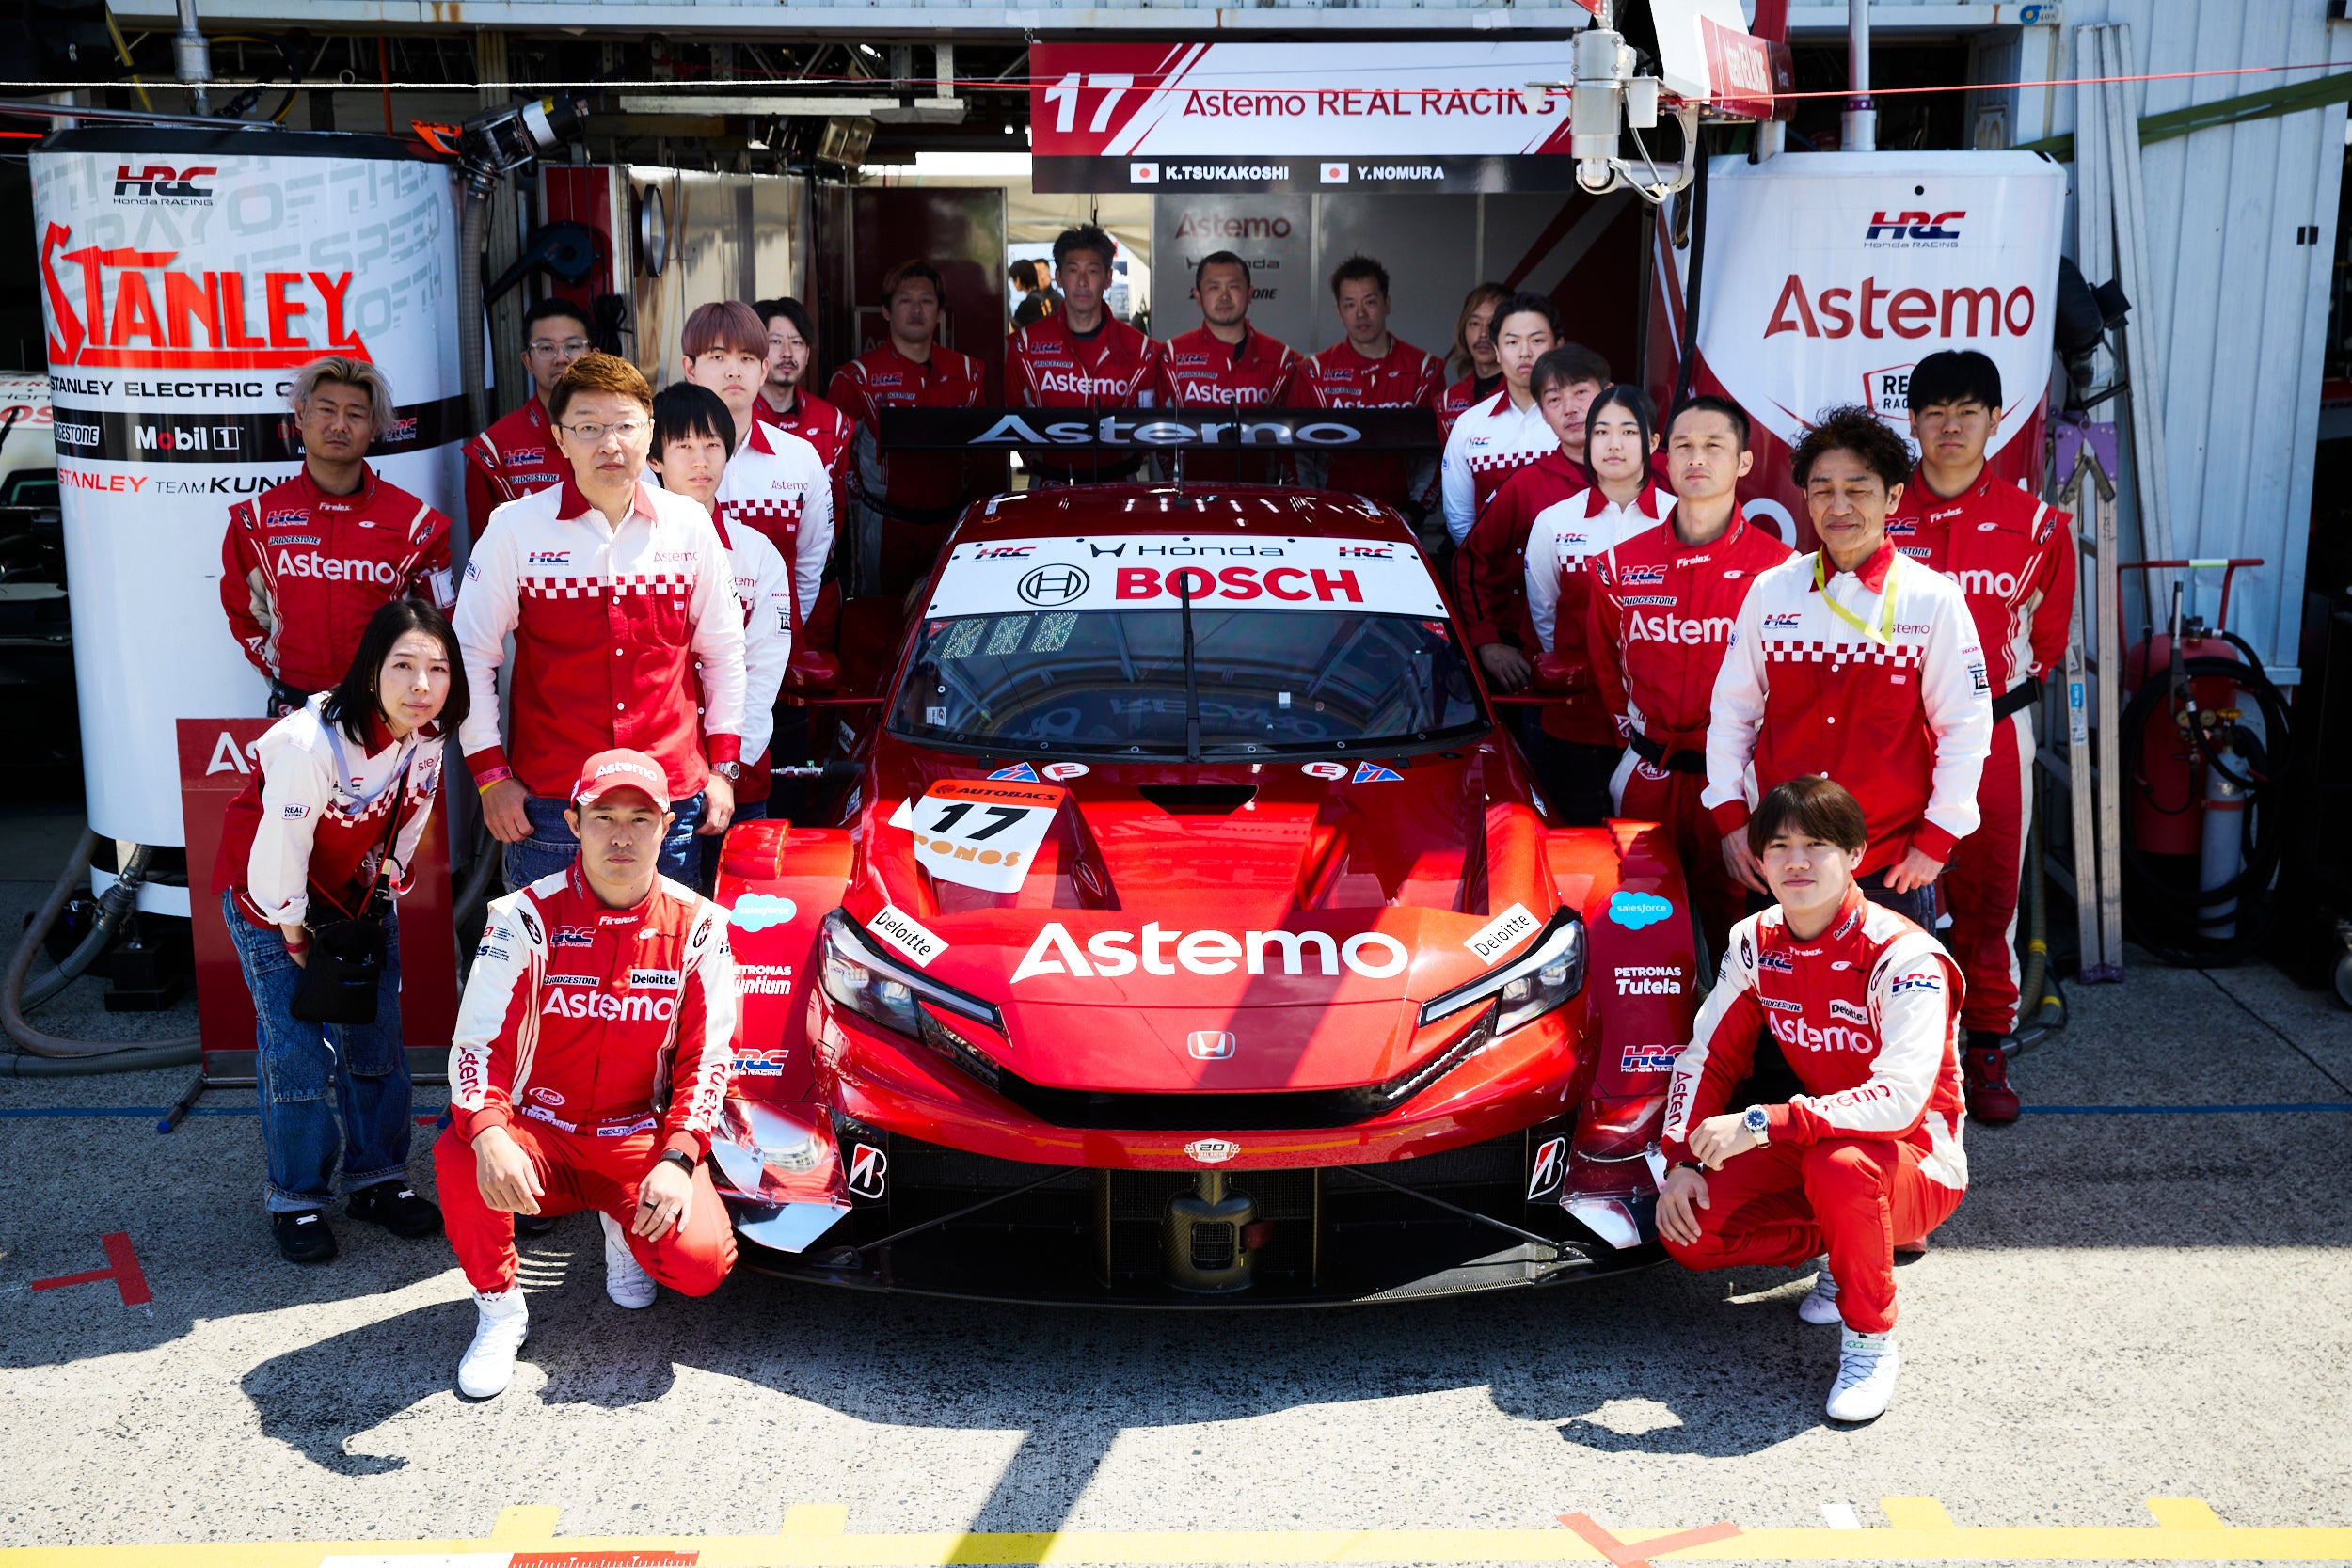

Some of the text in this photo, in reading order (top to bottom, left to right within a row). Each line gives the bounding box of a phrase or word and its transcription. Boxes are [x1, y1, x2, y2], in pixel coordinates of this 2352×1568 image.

[1044, 72, 1134, 132] 17
[1183, 87, 1306, 118] Astemo
[1318, 88, 1411, 116] REAL
[114, 166, 217, 197] HRC
[1165, 166, 1290, 182] K.TSUKAKOSHI
[1357, 166, 1445, 182] Y.NOMURA
[161, 198, 214, 207] RACING
[1175, 212, 1292, 240] Astemo
[1866, 211, 1966, 239] HRC
[41, 221, 354, 365] STANLEY
[1763, 274, 2035, 340] Astemo
[50, 375, 114, 396] STANLEY
[124, 382, 263, 398] ELECTRIC
[1041, 371, 1129, 396] Astemo
[1184, 381, 1270, 404] Astemo
[135, 426, 208, 451] Mobil
[968, 415, 1362, 444] Astemo
[59, 467, 149, 493] STANLEY
[155, 481, 205, 494] TEAM
[1138, 545, 1284, 557] Honda
[277, 549, 396, 584] Astemo
[1116, 566, 1364, 603] BOSCH
[1629, 610, 1736, 644] Astem
[595, 760, 658, 782] Astemo
[958, 788, 1057, 800] AUTOBACS
[930, 803, 1031, 841] 17
[1617, 903, 1667, 914] salesforce
[875, 911, 931, 957] Deloitte
[1473, 914, 1531, 957] Deloitte
[1010, 921, 1408, 985] Astemo
[631, 974, 678, 986] Deloitte
[1614, 967, 1681, 978] PETRONAS
[733, 977, 791, 996] yntium
[1615, 978, 1681, 995] Tutela
[541, 988, 675, 1022] Astemo
[1769, 1011, 1874, 1054] Astemo
